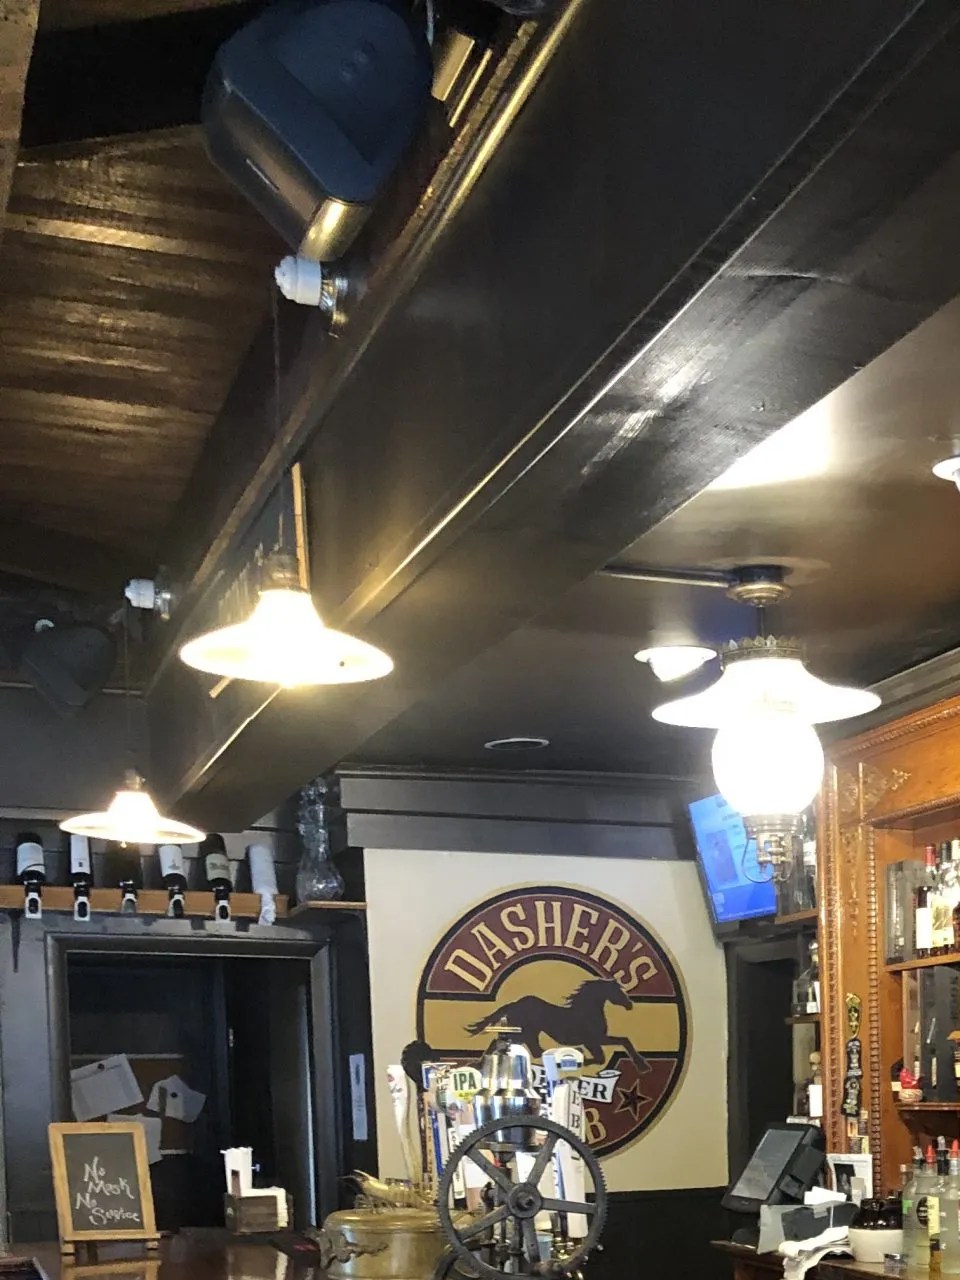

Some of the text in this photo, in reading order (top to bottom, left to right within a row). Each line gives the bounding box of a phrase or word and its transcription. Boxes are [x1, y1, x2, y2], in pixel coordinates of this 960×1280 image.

[444, 900, 657, 992] DASHER'S
[452, 1070, 477, 1089] IPA
[83, 1156, 106, 1184] No
[75, 1193, 97, 1209] No
[89, 1207, 140, 1225] Service
